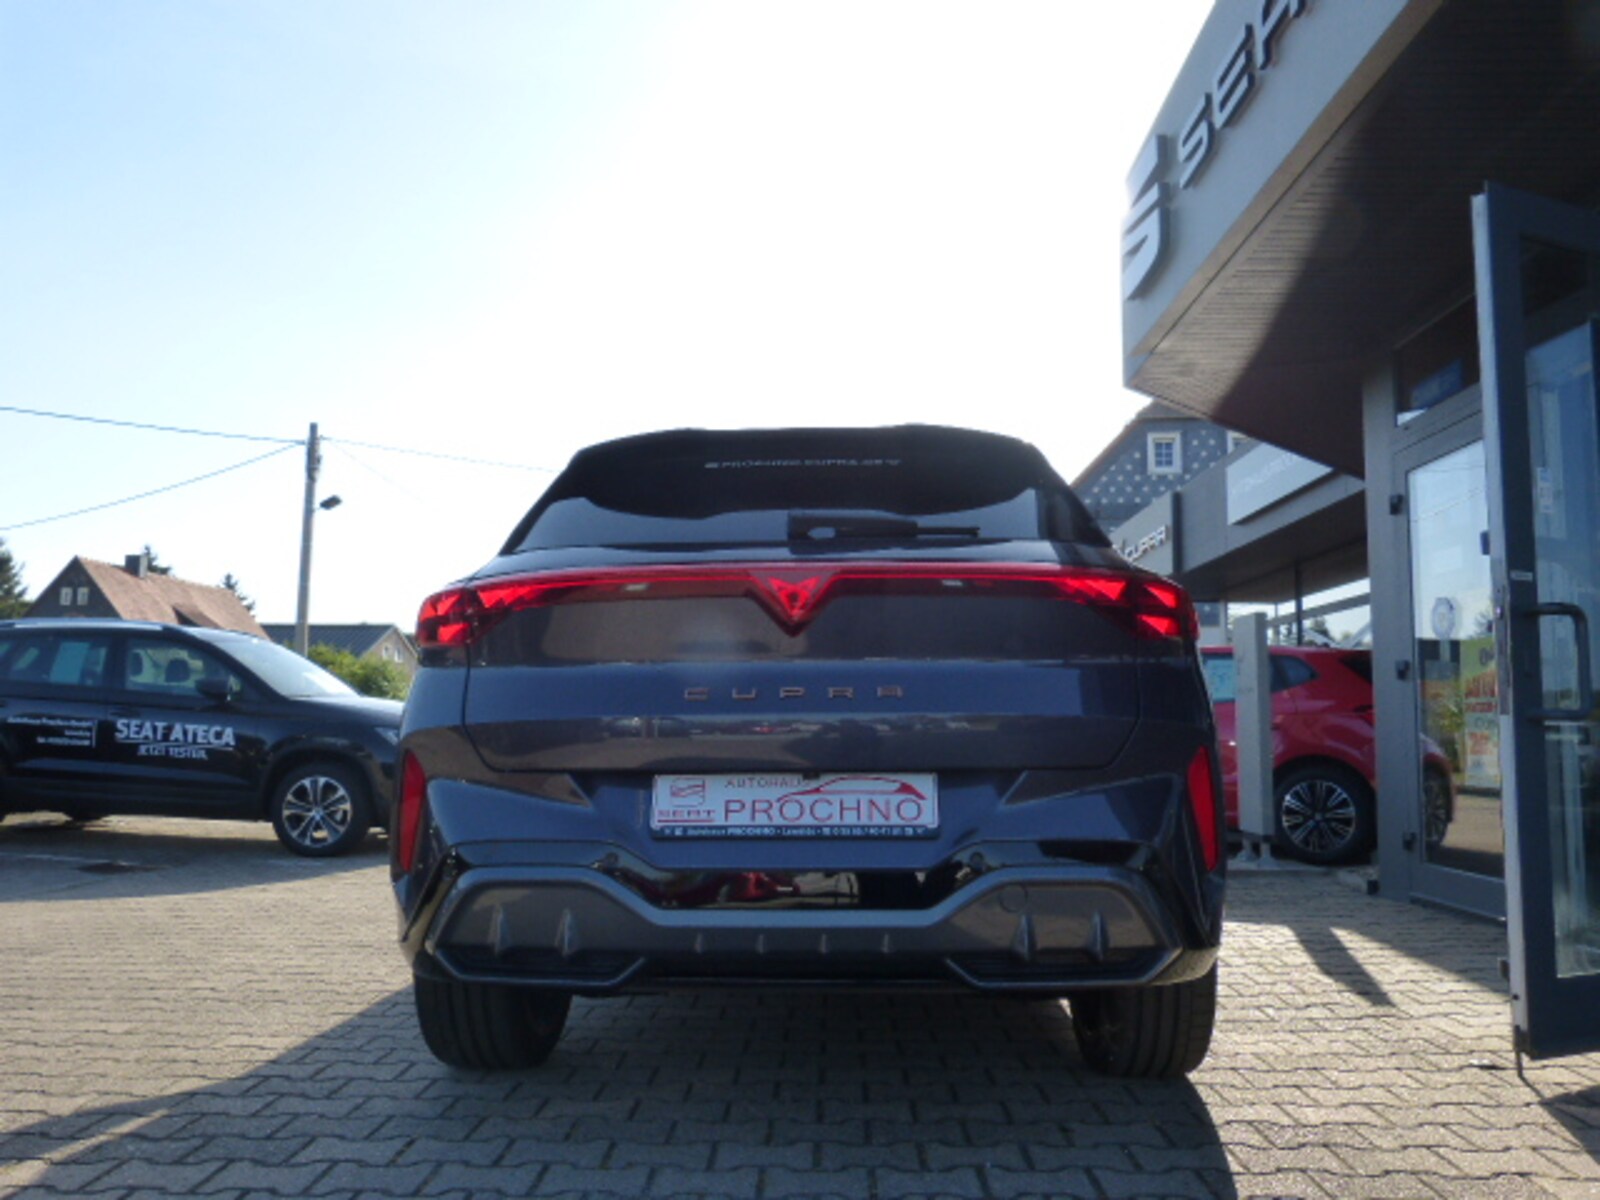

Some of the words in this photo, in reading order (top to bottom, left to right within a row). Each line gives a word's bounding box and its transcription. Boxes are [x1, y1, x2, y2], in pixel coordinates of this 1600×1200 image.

[684, 686, 904, 699] CUPRA
[115, 718, 169, 742] SEAT
[169, 722, 236, 746] ATECA
[657, 809, 716, 818] SEAT
[724, 798, 923, 823] PROCHNO
